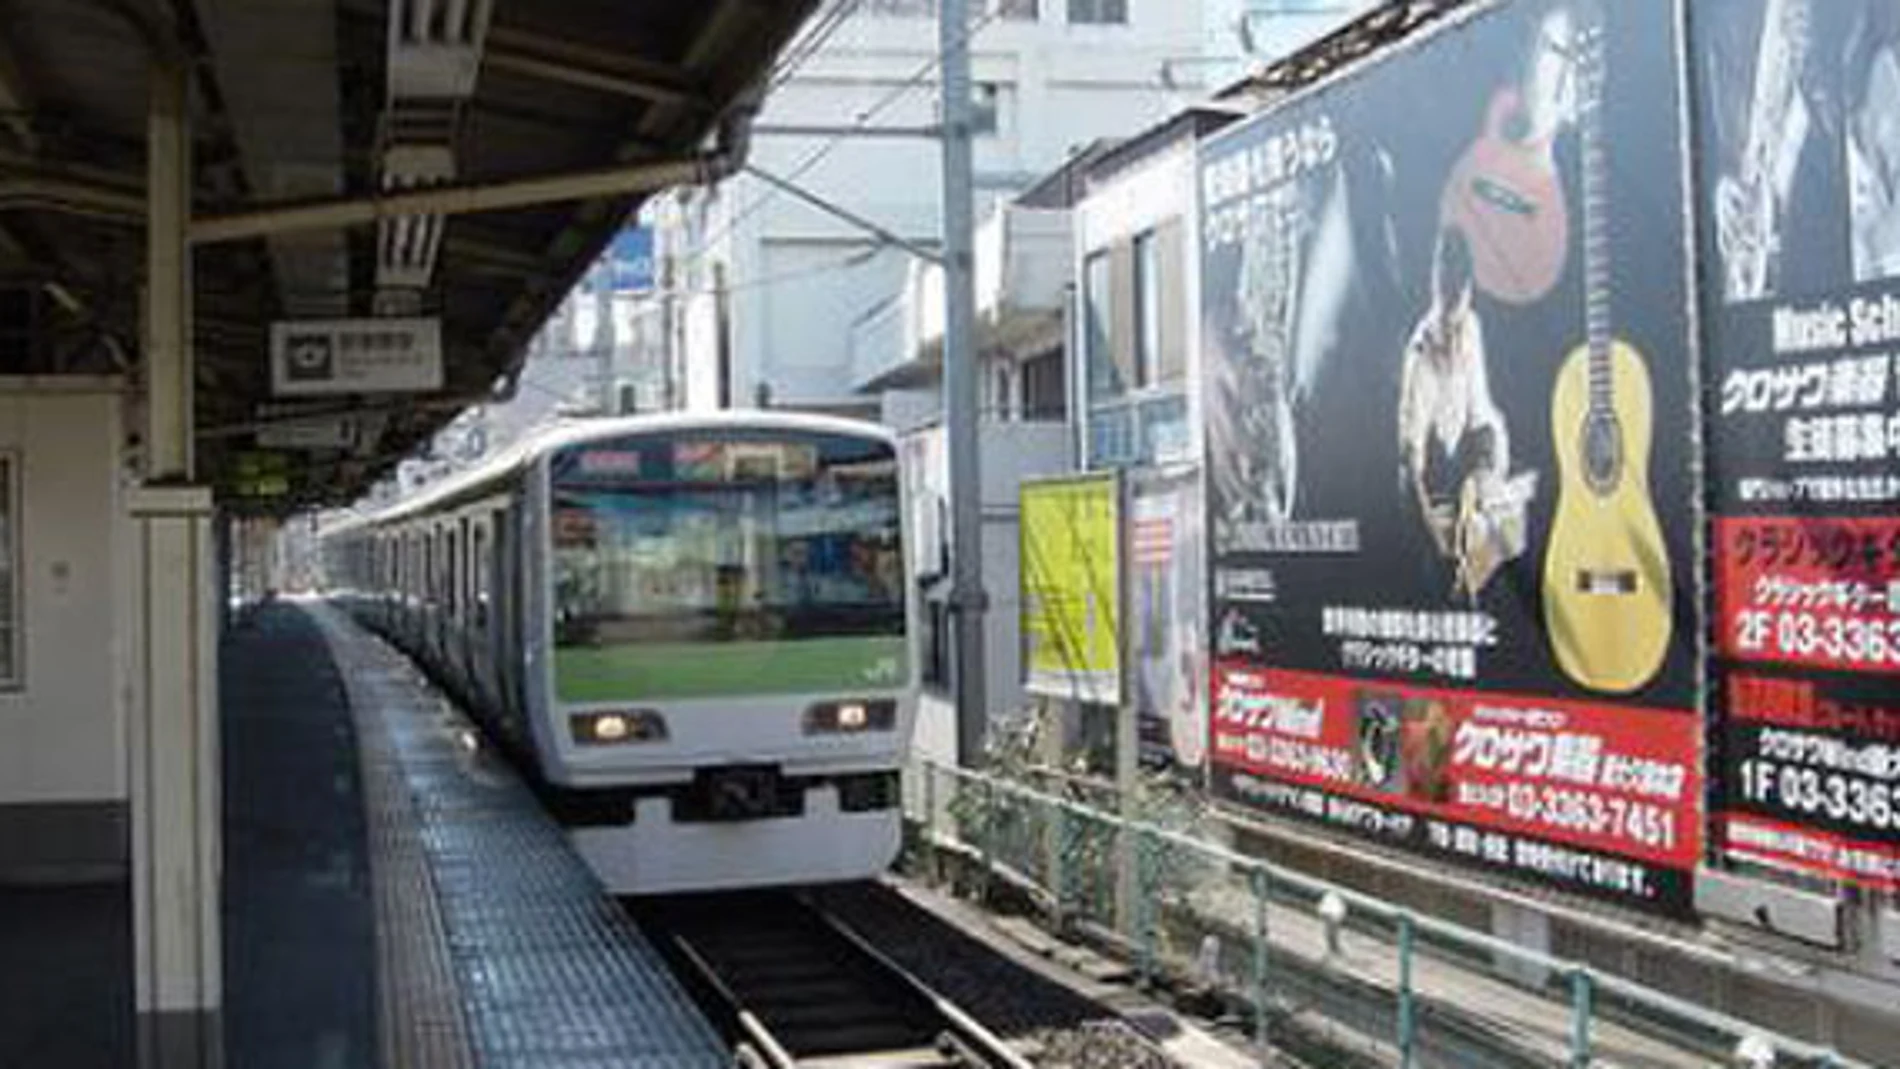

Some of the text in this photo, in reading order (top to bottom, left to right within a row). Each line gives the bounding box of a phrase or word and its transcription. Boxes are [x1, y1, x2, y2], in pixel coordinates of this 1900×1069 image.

[1773, 302, 1848, 353] Music
[1735, 610, 1770, 650] 2F
[1740, 758, 1775, 800] 1F
